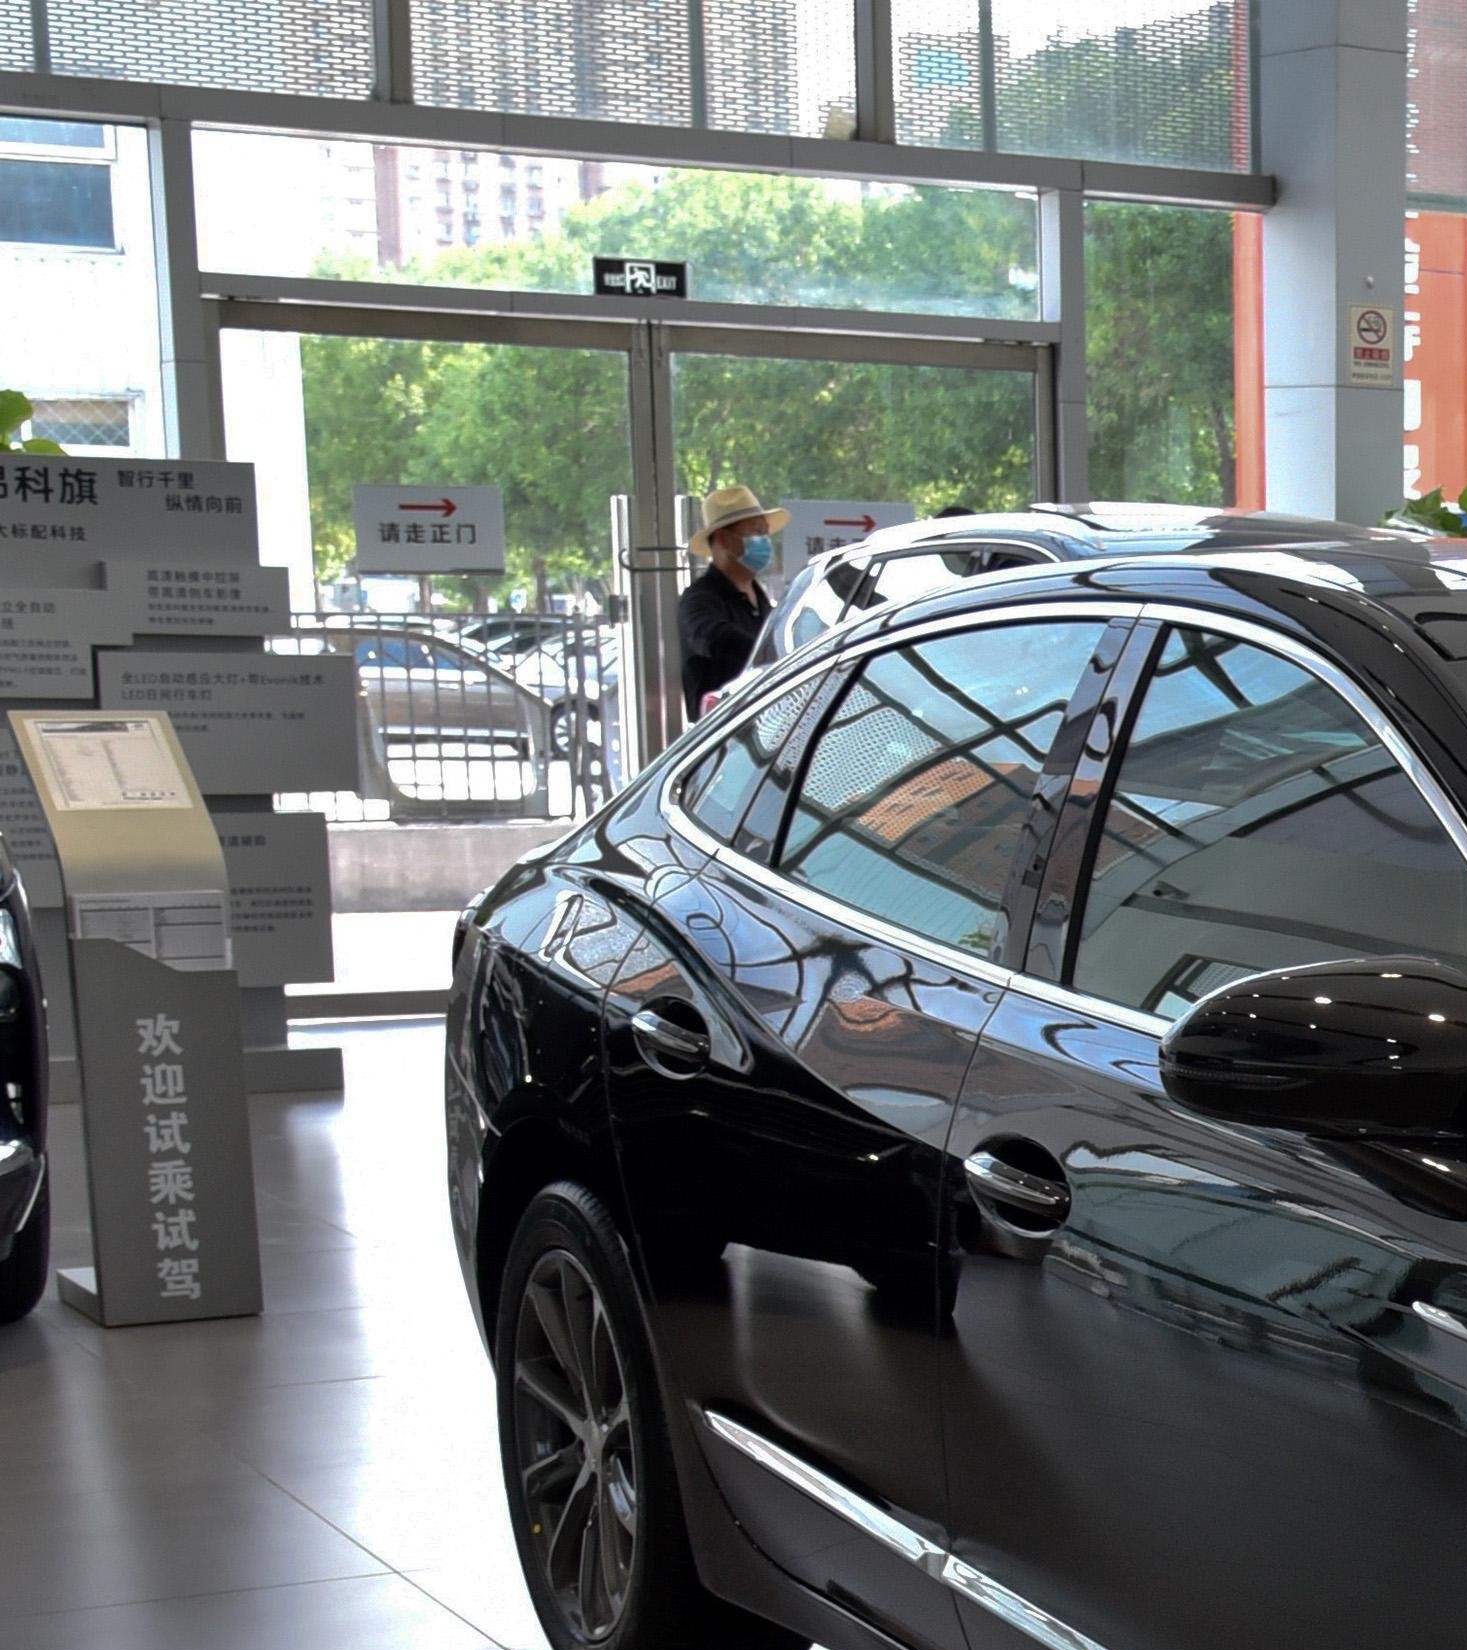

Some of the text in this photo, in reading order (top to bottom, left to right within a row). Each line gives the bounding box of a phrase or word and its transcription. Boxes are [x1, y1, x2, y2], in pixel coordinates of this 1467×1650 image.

[0, 466, 98, 505] 科旗
[117, 469, 195, 489] 智行千里
[165, 494, 243, 514] 纵情向前
[378, 522, 478, 546] 请走正门
[135, 1012, 201, 1300] 欢迎试乘试驾
